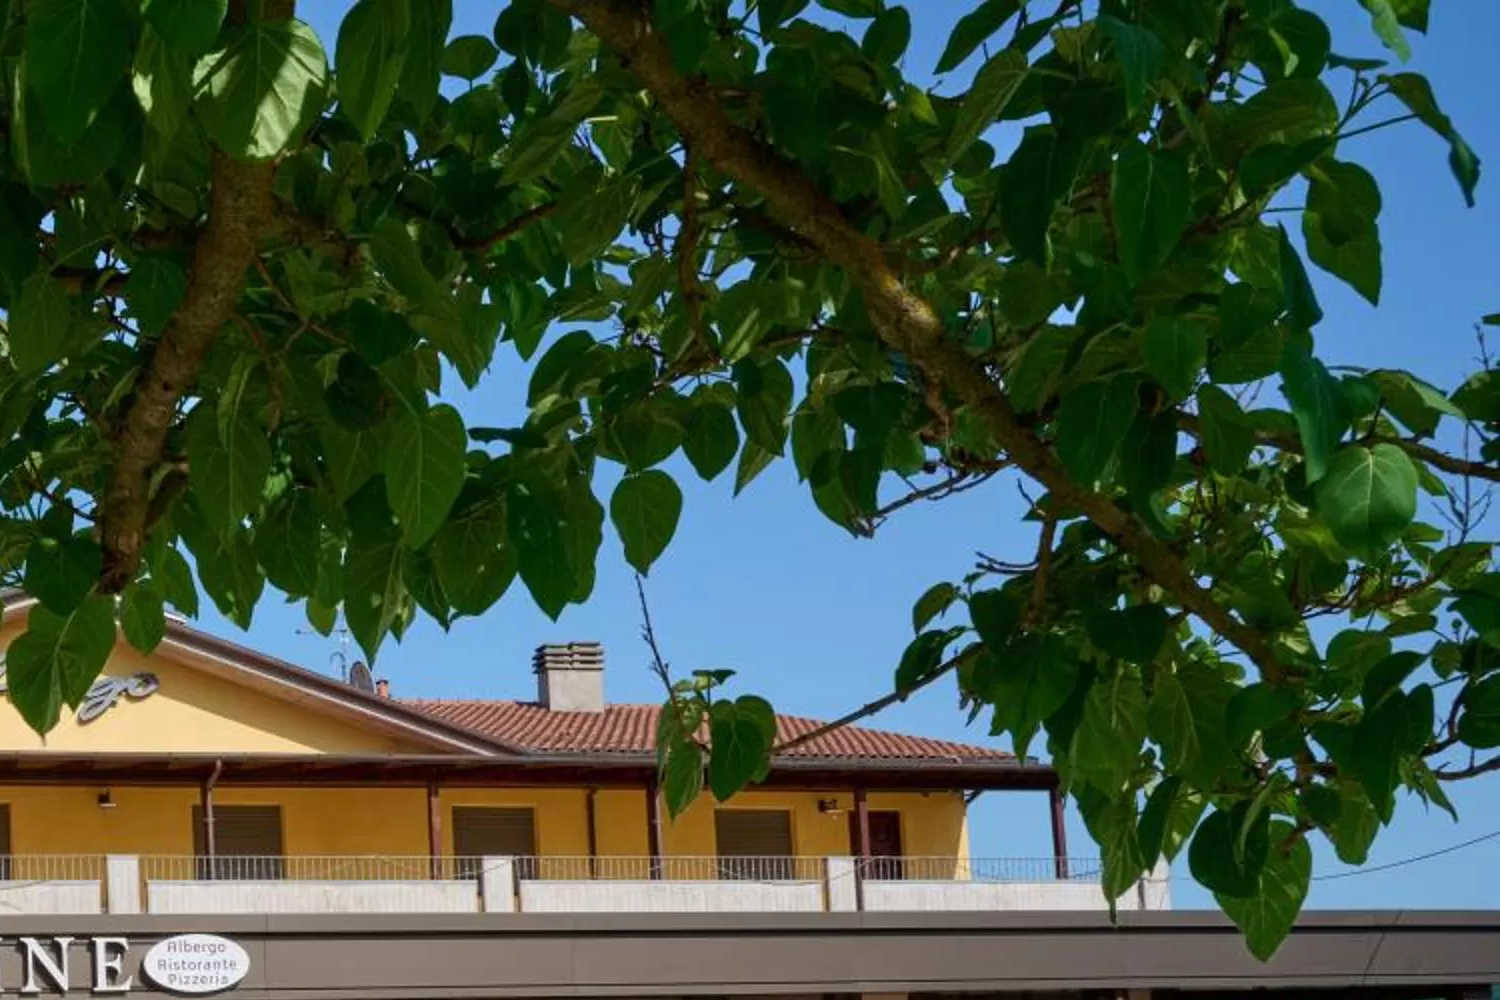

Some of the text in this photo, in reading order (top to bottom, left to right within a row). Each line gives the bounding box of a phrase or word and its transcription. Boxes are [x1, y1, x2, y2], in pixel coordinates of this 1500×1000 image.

[167, 939, 226, 956] Albergo
[157, 958, 236, 970] Ristorante
[167, 973, 229, 985] Pizzeria
